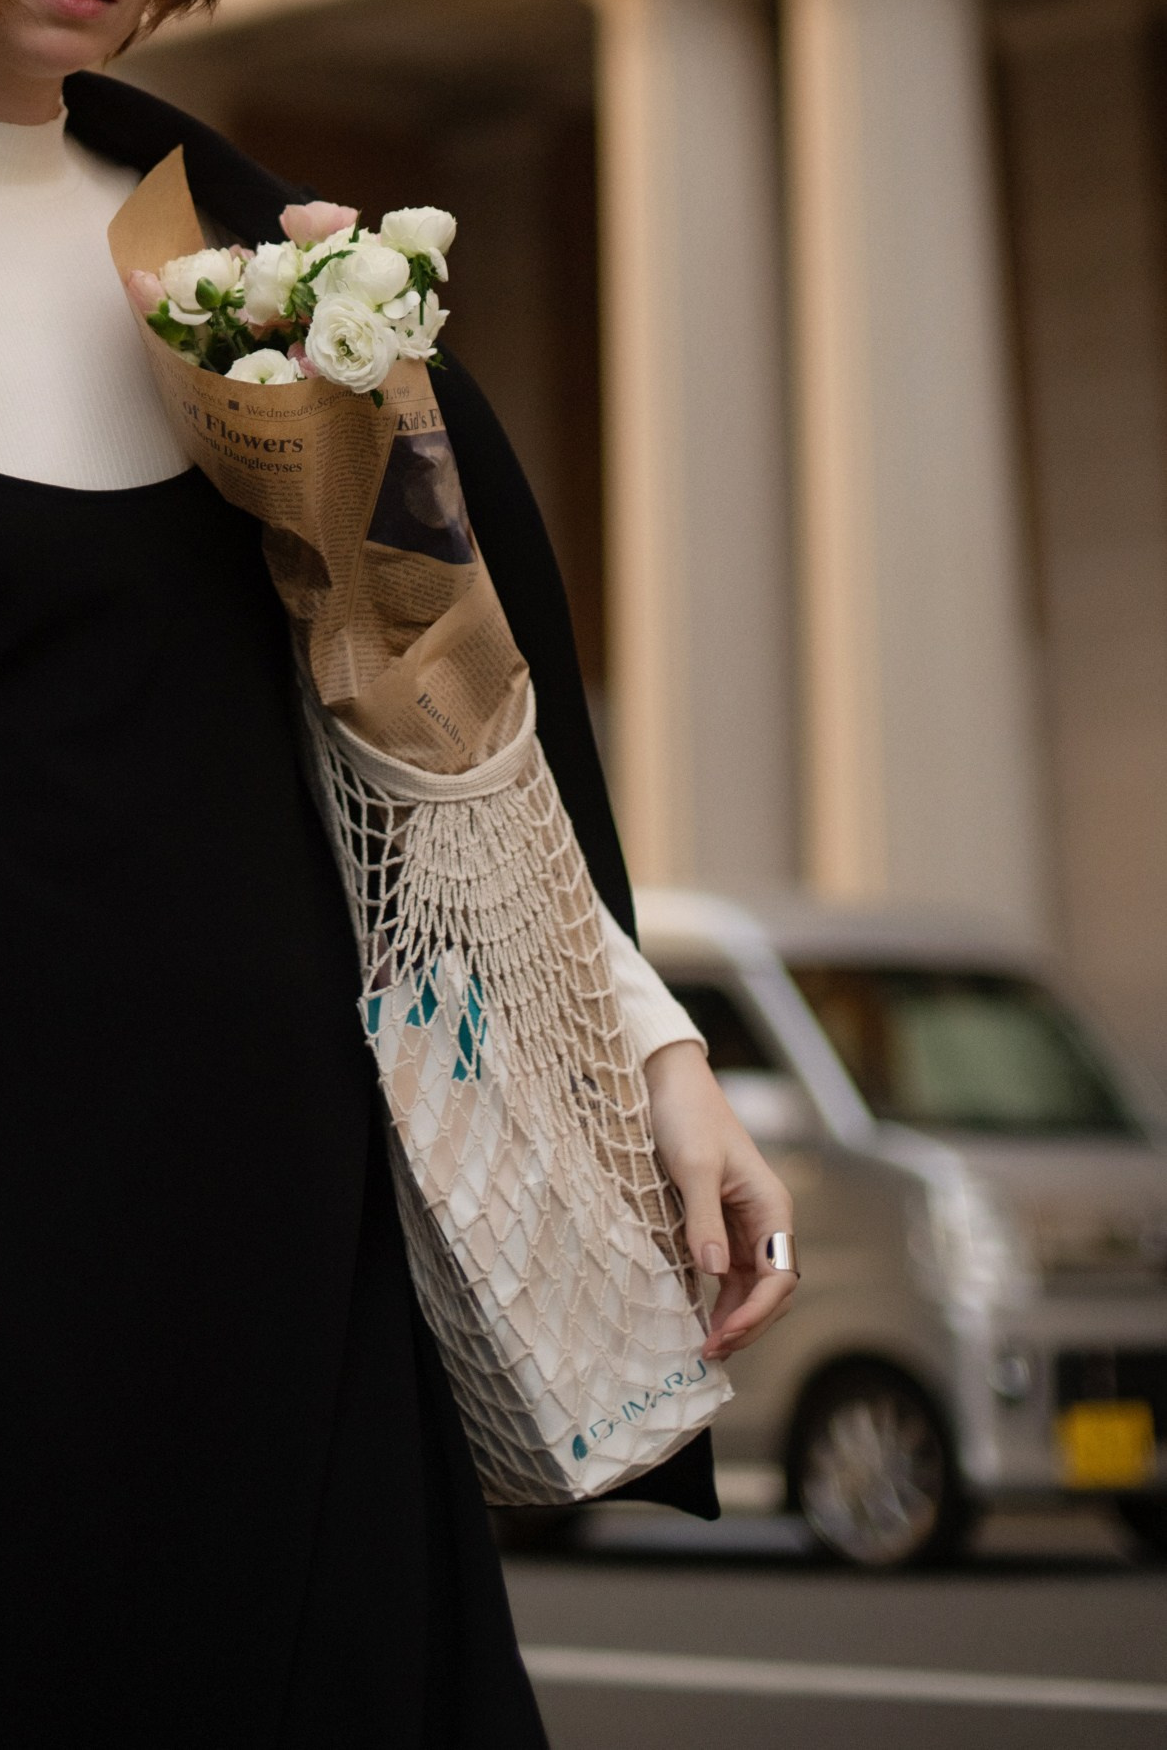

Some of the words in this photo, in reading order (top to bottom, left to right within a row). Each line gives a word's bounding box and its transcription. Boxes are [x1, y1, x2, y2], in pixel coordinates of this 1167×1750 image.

[205, 414, 304, 453] Flowers
[397, 411, 428, 431] Kid's
[224, 445, 303, 474] Dangleeyses
